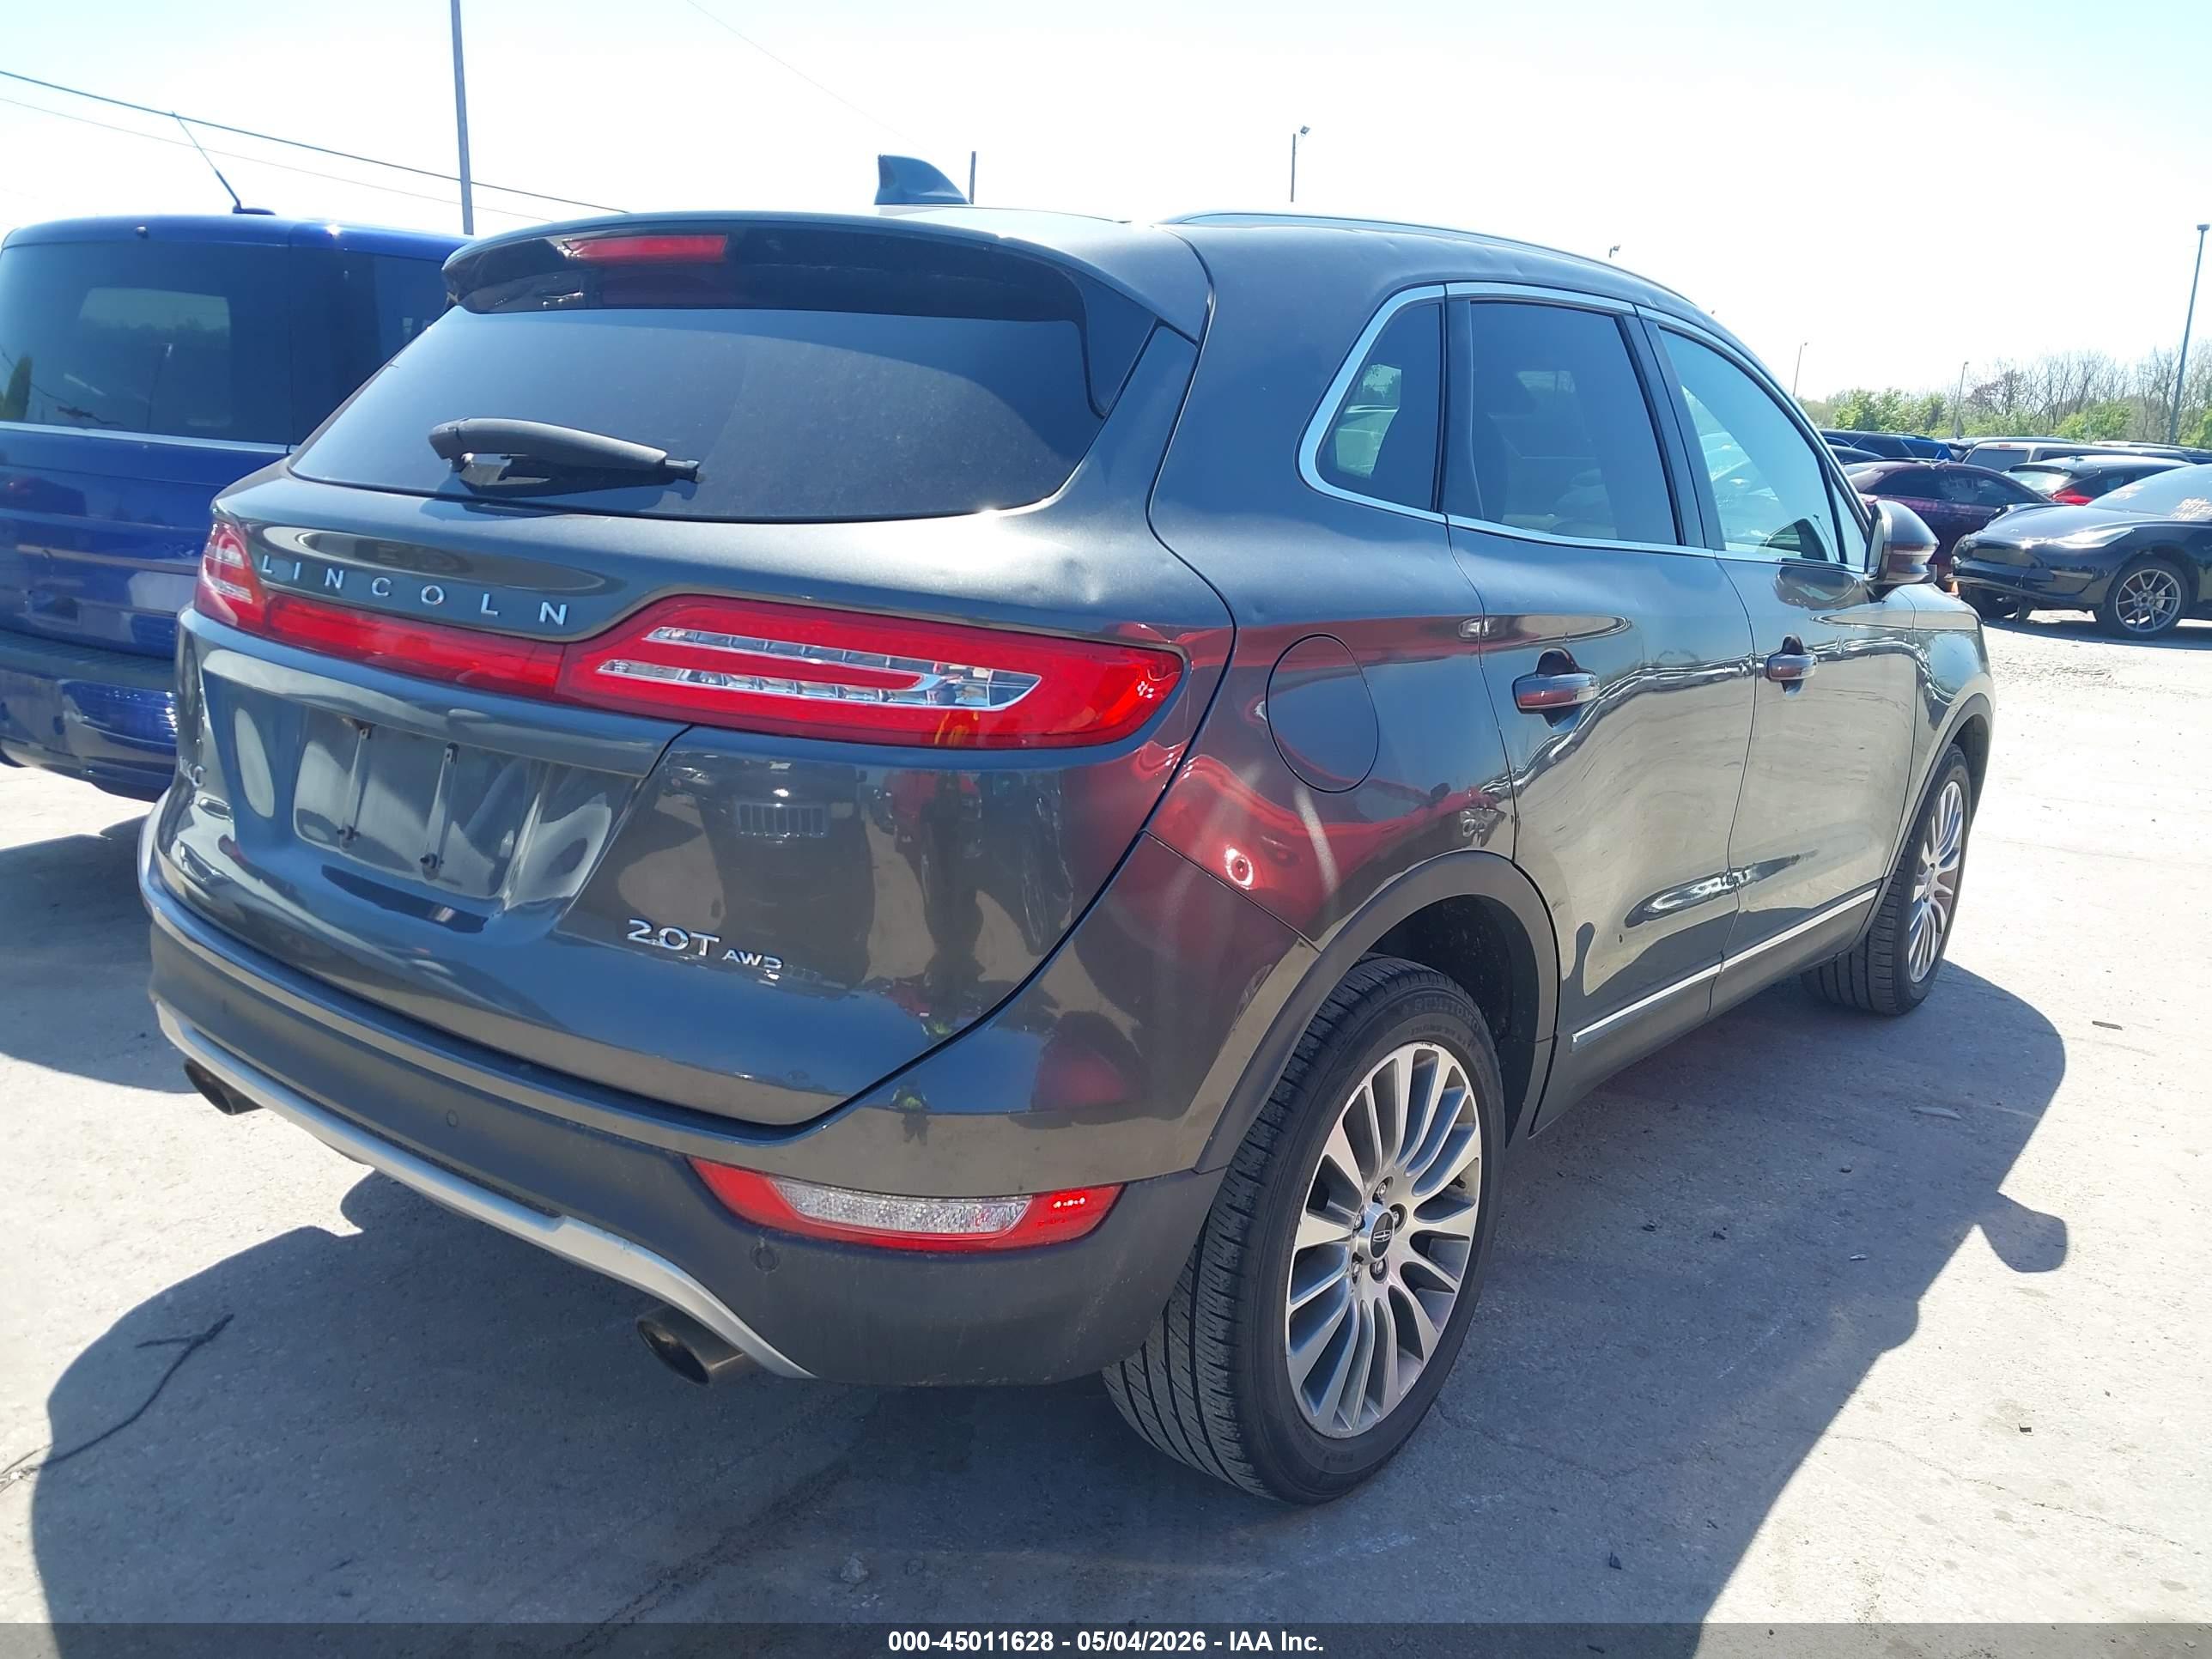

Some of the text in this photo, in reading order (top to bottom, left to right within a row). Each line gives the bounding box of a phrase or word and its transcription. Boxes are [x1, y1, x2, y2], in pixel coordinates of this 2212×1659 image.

[261, 555, 568, 626] LINCOLN
[627, 918, 784, 970] 2.0T AWD
